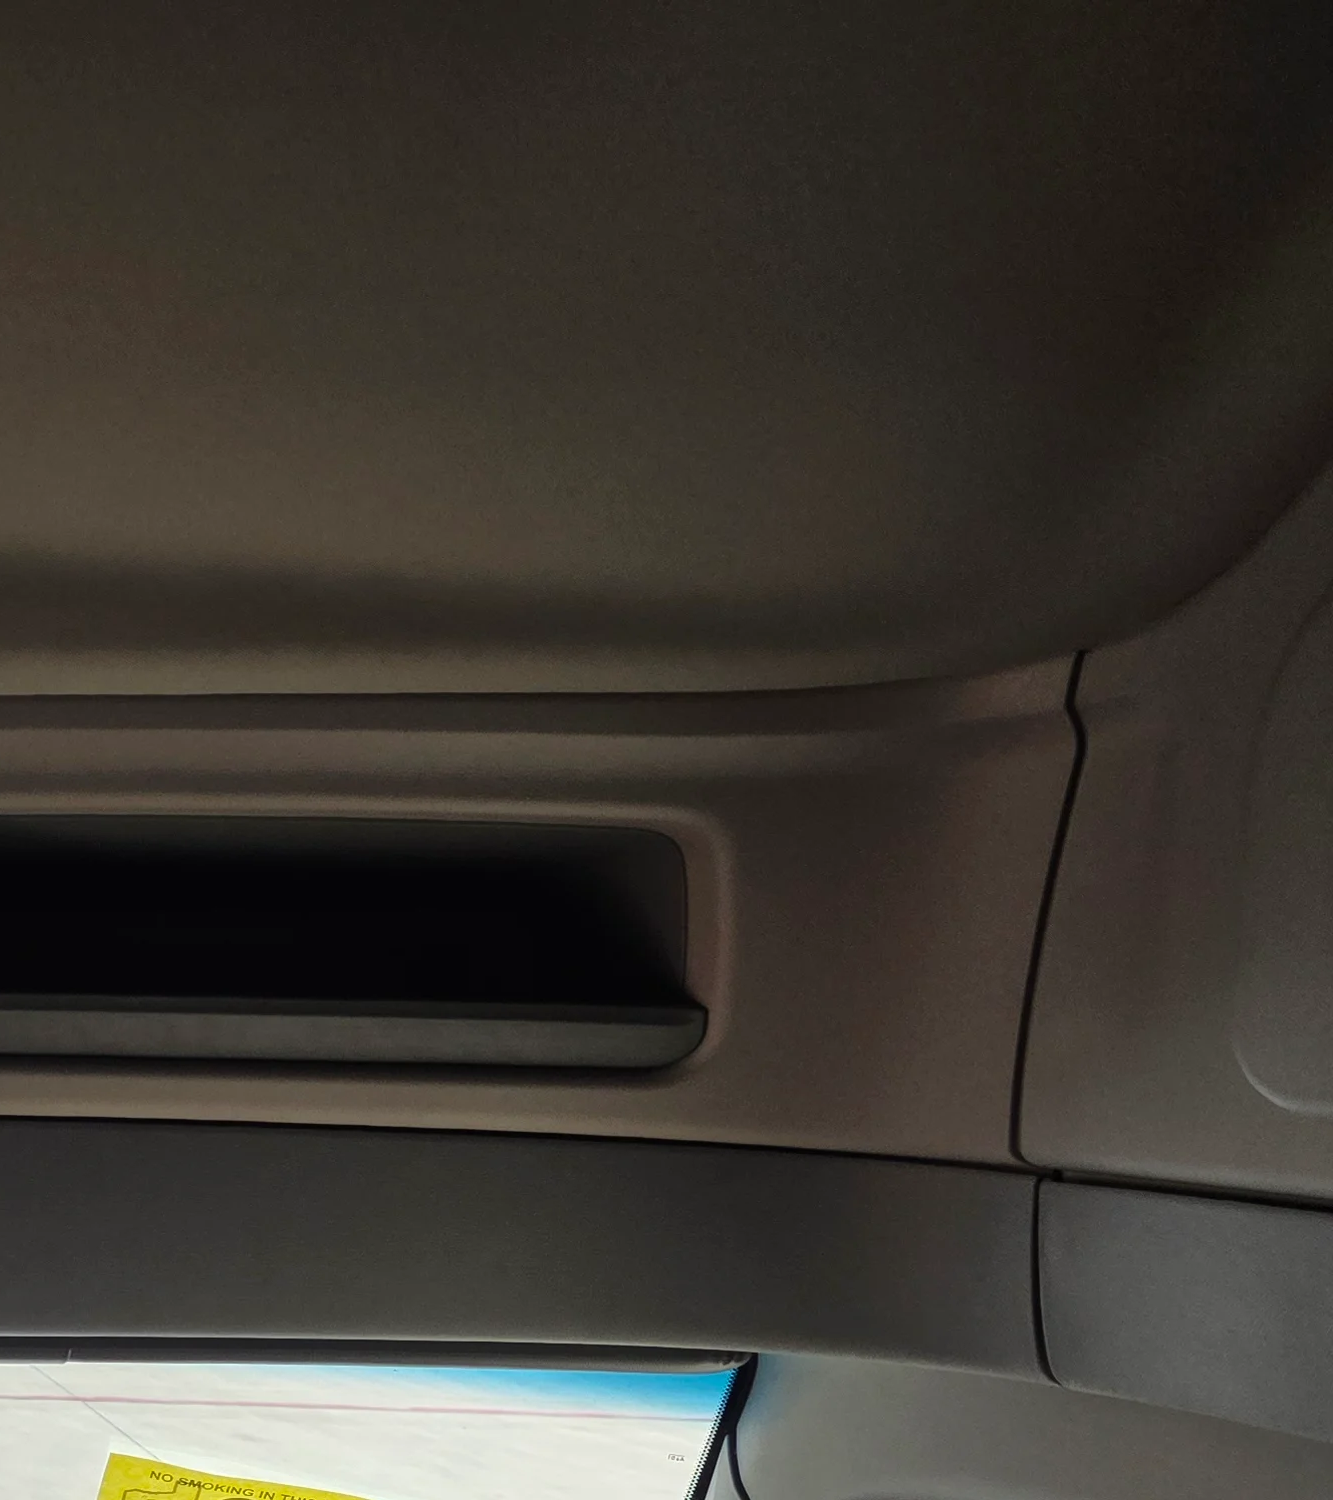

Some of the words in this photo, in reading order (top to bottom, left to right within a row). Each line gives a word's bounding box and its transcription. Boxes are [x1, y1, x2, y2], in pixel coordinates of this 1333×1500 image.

[150, 1471, 173, 1482] NO
[177, 1478, 254, 1497] SMOKING
[259, 1491, 275, 1500] IN
